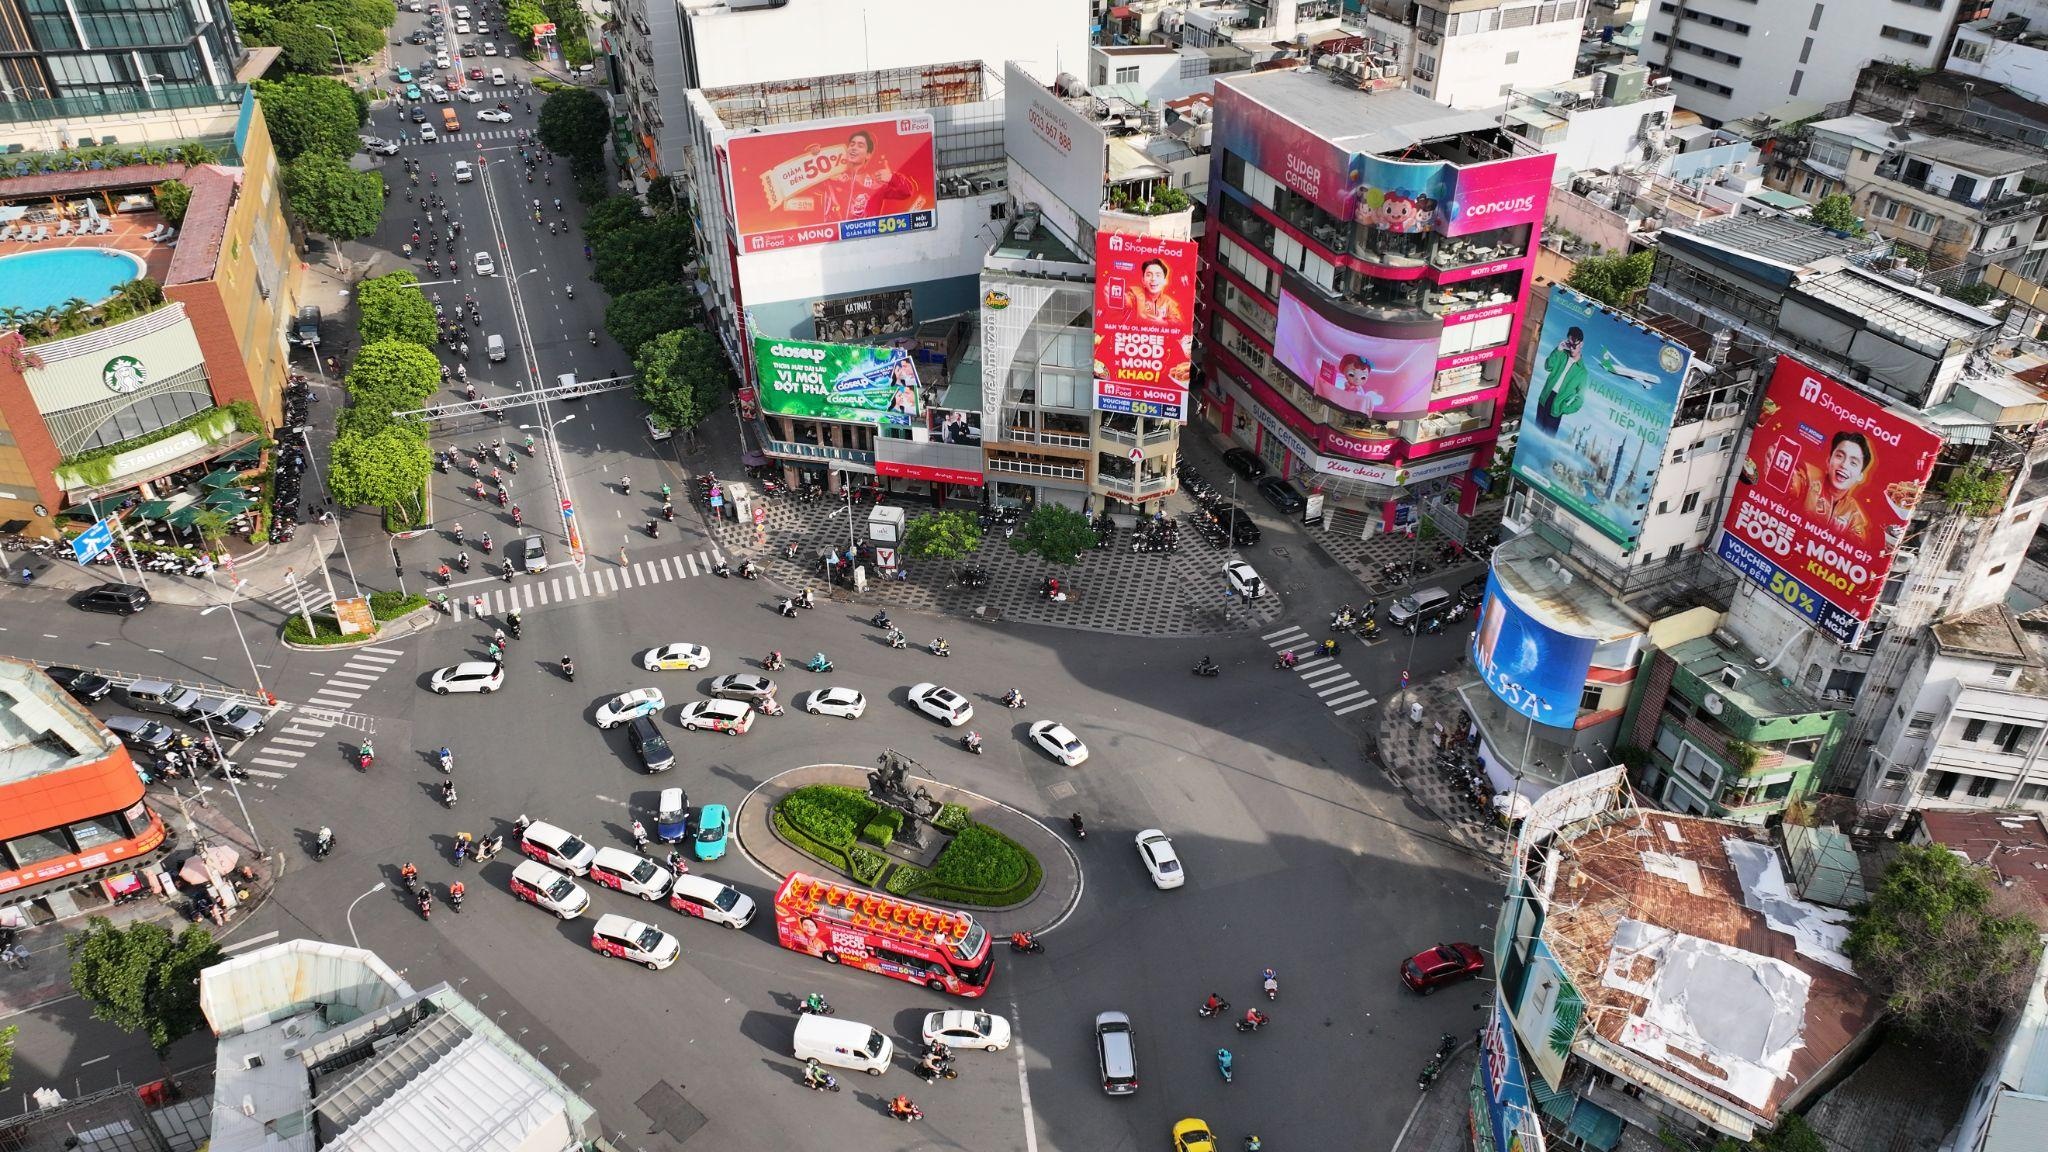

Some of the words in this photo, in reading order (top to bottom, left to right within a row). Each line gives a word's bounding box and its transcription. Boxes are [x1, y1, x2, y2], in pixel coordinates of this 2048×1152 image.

[804, 153, 847, 179] 50%
[846, 220, 877, 230] VOUCHER
[878, 217, 907, 233] 50%
[766, 239, 785, 248] Food
[798, 227, 834, 242] MONO
[1124, 241, 1183, 257] ShopeeFood
[1114, 332, 1164, 346] SHOPEE
[770, 343, 825, 364] closeup
[1114, 342, 1165, 358] FOOD
[1121, 357, 1163, 371] MONO
[1118, 369, 1160, 383] KHAO!
[1144, 390, 1176, 401] MONO
[1103, 397, 1131, 406] VOUCHER
[1131, 401, 1157, 414] 50%
[1609, 407, 1636, 430] TIẾP
[1819, 392, 1901, 447] ShopeeFood
[119, 436, 198, 469] STARBUCKS
[783, 444, 867, 461] KATINAT
[1748, 489, 1768, 506] BẠN
[1770, 501, 1789, 518] YÊU
[1741, 501, 1796, 541] SHOPEE
[1735, 512, 1791, 556] FOOD
[1806, 540, 1867, 584] MONO
[1725, 551, 1747, 571] GIẢM
[1729, 538, 1772, 575] VOUCHER
[1769, 571, 1814, 614] 50%
[1807, 560, 1856, 596] KHAO!
[832, 930, 865, 944] SHOPEE
[832, 937, 866, 950] FOOD
[833, 945, 869, 959] MONO
